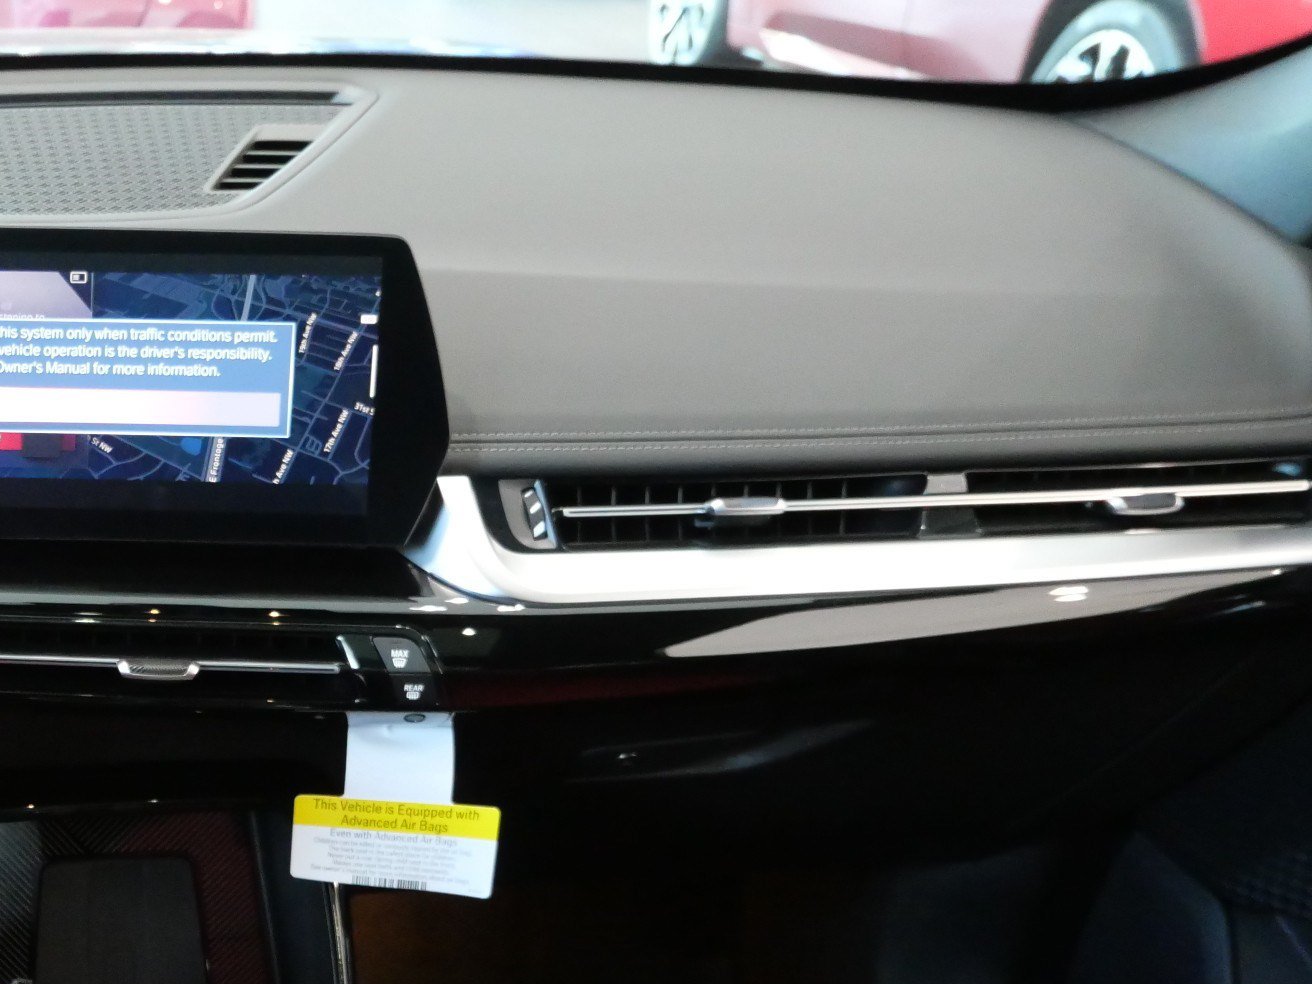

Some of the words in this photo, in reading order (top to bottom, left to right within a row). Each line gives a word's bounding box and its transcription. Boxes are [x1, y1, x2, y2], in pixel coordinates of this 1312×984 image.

[20, 327, 64, 342] system
[66, 327, 93, 342] only
[94, 327, 127, 341] when
[130, 328, 165, 341] traffic
[167, 328, 232, 342] conditions
[234, 330, 278, 344] permit.
[43, 344, 102, 359] operation
[104, 345, 115, 357] is
[117, 346, 137, 358] the
[140, 346, 185, 359] driver's
[187, 347, 273, 363] responsibility.
[45, 361, 90, 374] Manual
[92, 361, 110, 375] for
[112, 364, 145, 375] more
[147, 363, 221, 377] information.
[323, 437, 336, 453] 17th
[331, 423, 343, 439] Ave
[337, 409, 349, 424] NW
[98, 442, 114, 454] NW
[282, 448, 294, 464] NW
[210, 438, 224, 477] Frontage
[390, 649, 409, 658] MAX
[403, 684, 425, 692] REAR
[313, 798, 337, 811] This
[340, 801, 382, 814] Vehicle
[385, 804, 394, 814] is
[398, 804, 453, 819] Equipped
[456, 809, 480, 820] with
[341, 814, 397, 829] Advanced
[400, 819, 416, 830] Air
[419, 820, 448, 834] Bags
[330, 828, 352, 838] Even
[353, 830, 372, 839] with
[374, 831, 418, 843] Advanced
